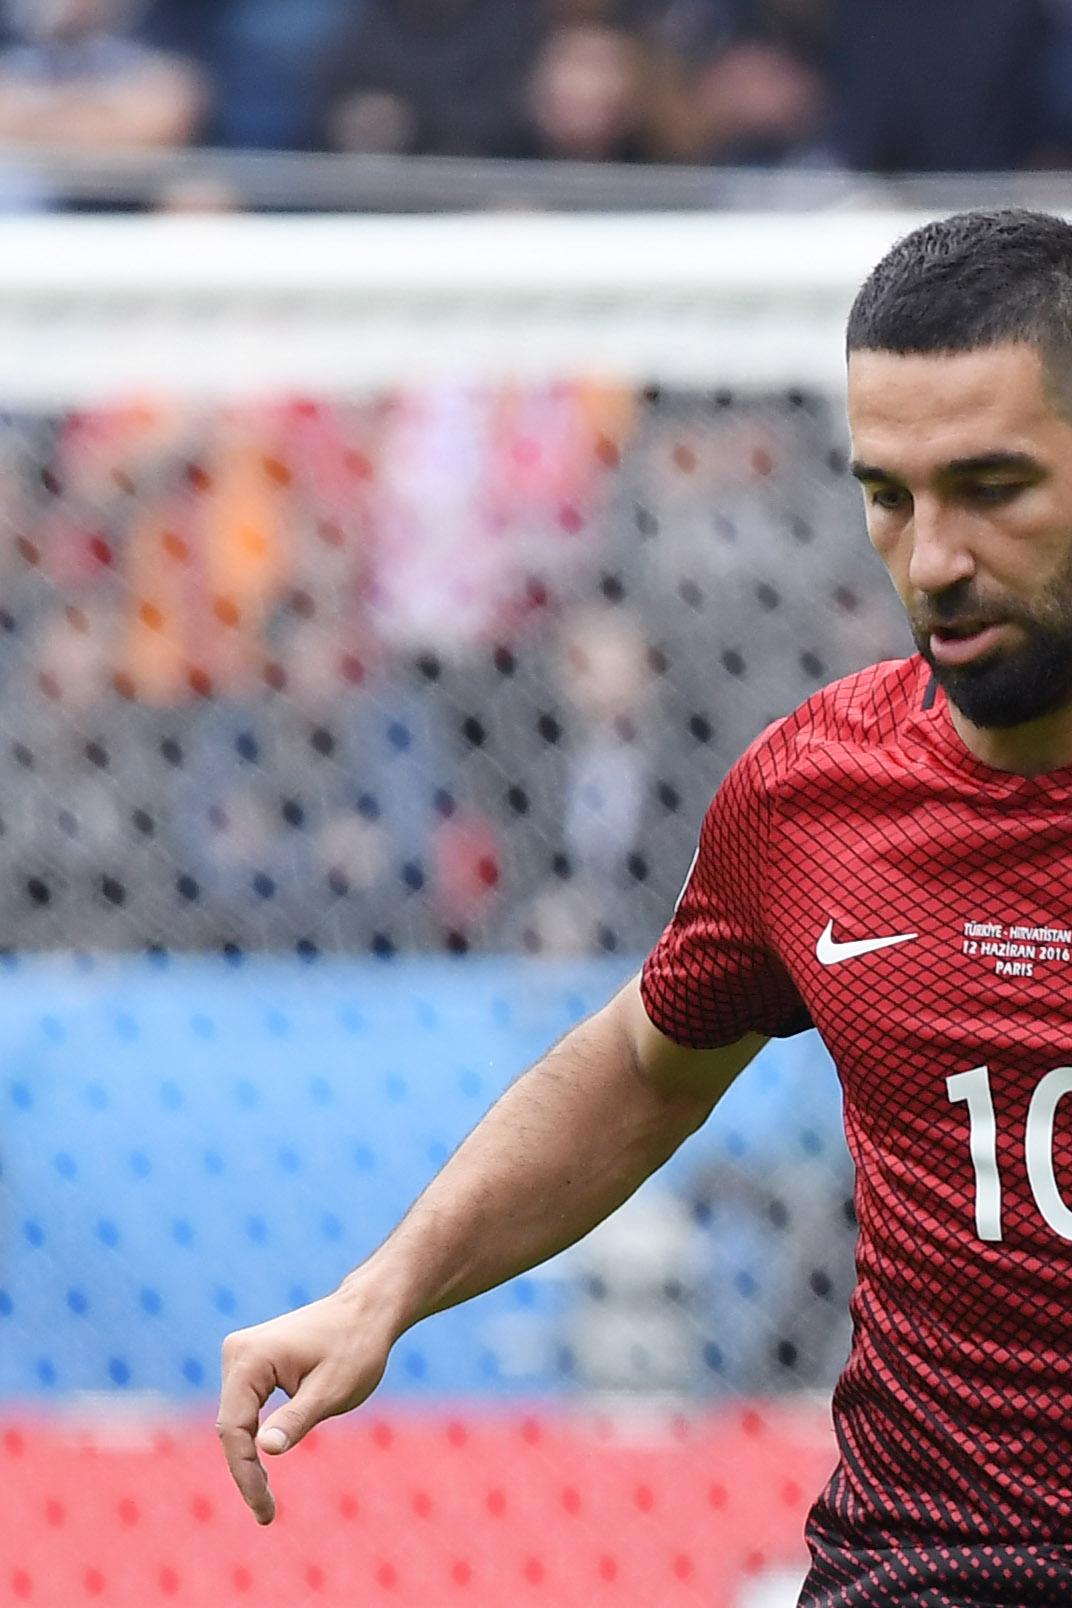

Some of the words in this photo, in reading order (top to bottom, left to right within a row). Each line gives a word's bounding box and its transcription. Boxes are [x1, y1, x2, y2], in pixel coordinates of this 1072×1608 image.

[963, 940, 978, 954] 12
[981, 941, 1035, 958] HAZİRAN
[1039, 946, 1070, 961] 2016
[995, 961, 1033, 977] PARIS
